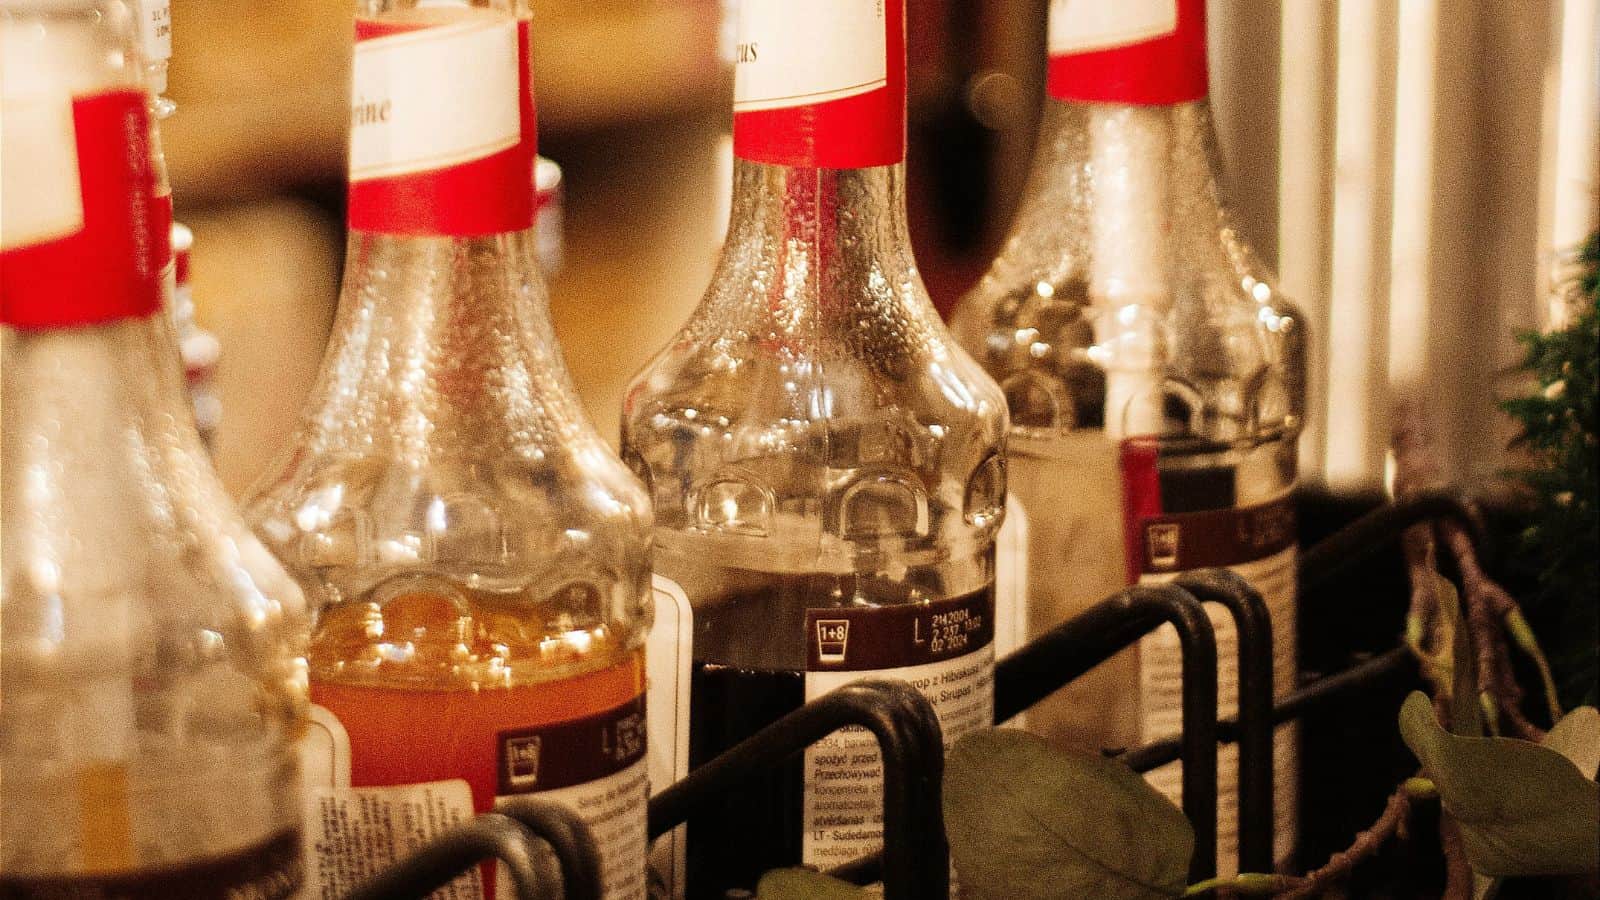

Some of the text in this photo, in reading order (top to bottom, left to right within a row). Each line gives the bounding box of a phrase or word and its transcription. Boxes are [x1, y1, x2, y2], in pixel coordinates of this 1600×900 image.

[820, 626, 845, 641] 1+8
[914, 617, 925, 643] L
[814, 830, 824, 841] LT
